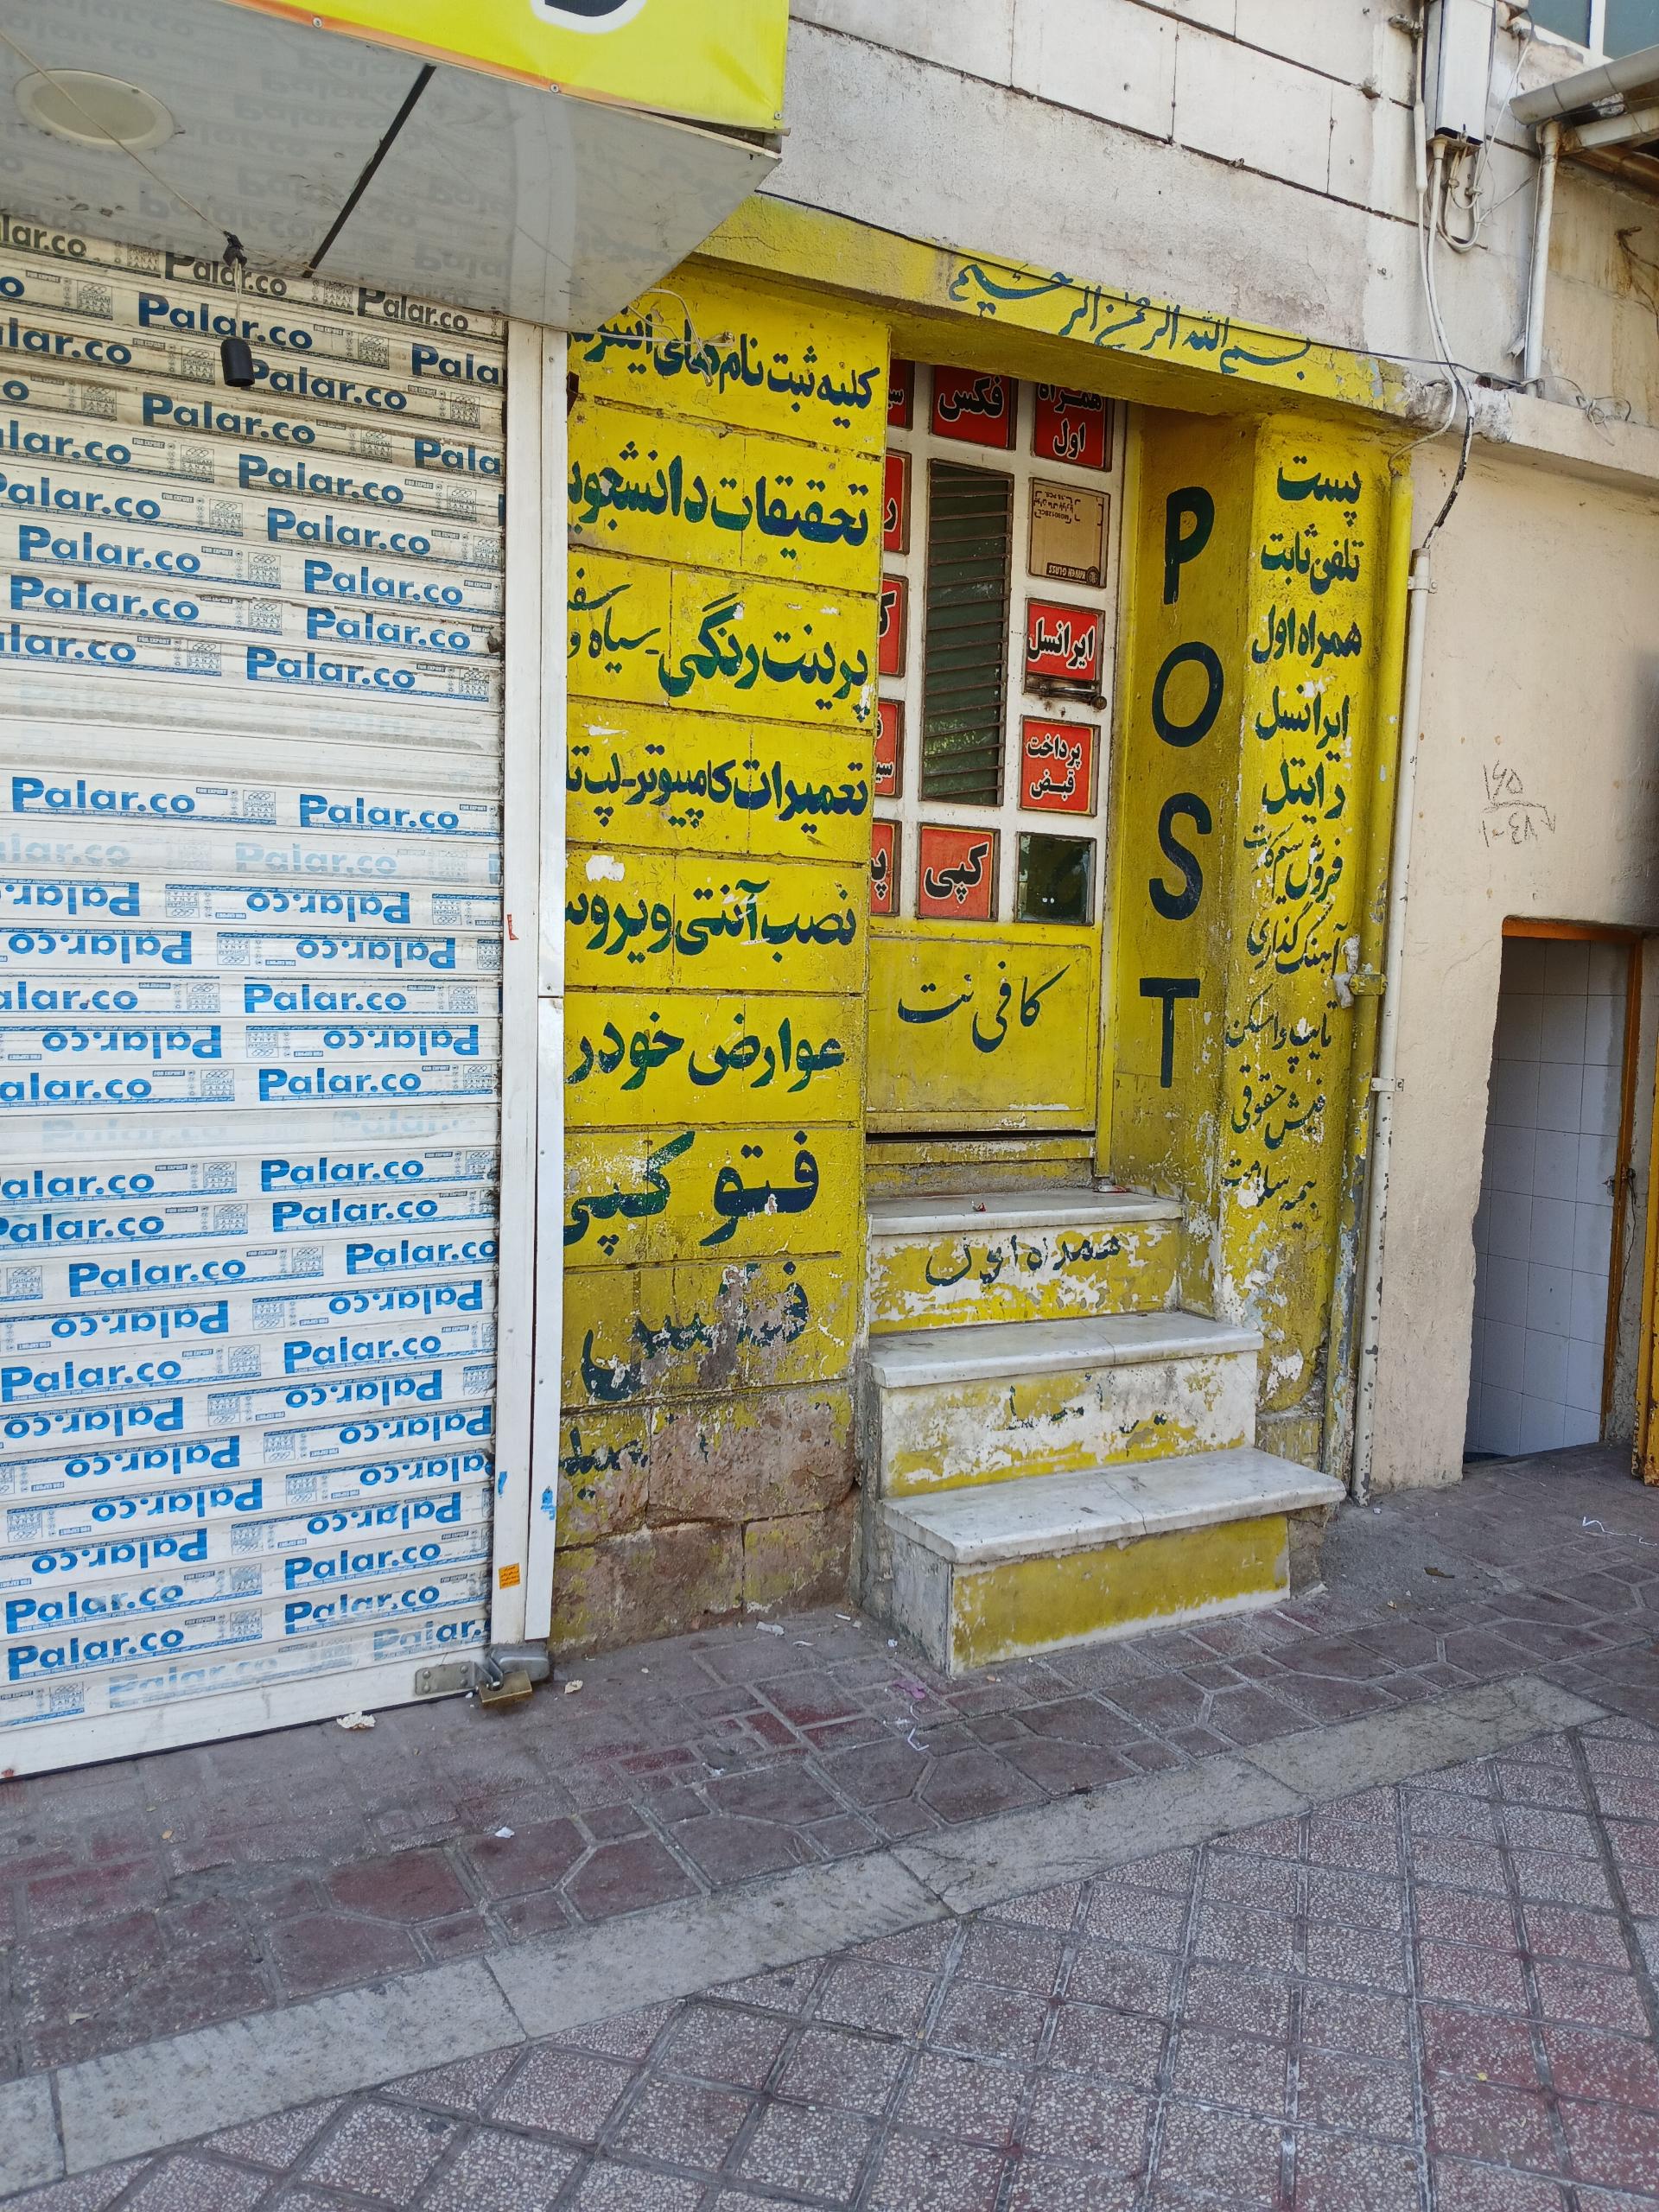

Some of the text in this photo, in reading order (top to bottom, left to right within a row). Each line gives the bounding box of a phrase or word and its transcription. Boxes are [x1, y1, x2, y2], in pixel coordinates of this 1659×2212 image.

[0, 215, 86, 257] lar.co
[165, 251, 287, 296] Palar.co
[138, 292, 312, 349] Palar.co
[358, 287, 468, 332] Palar.co
[654, 318, 720, 377] های
[719, 333, 763, 394] نام
[1220, 337, 1311, 380] بسم
[767, 346, 817, 413] ثبت
[817, 365, 880, 429] کلیه
[938, 376, 1003, 421] فکس
[143, 392, 315, 444] Palar.co
[1053, 419, 1085, 459] اول
[0, 421, 131, 466] lar.co
[0, 472, 161, 519] alar.co
[238, 453, 404, 505] Palar.co
[1277, 455, 1361, 527] پست
[267, 507, 430, 556] Palar.co
[711, 474, 868, 559] تحقیقات
[19, 524, 200, 574] Palar.co
[1261, 523, 1364, 594] تلفن ثابت
[10, 575, 199, 621] Palar.co
[304, 559, 463, 606] Palar.co
[0, 624, 136, 662] lar.co
[307, 607, 470, 651] Palar.co
[658, 591, 760, 696] رنگی
[1028, 616, 1095, 671] ایرانسل
[1251, 604, 1362, 668] همراه اول
[246, 646, 415, 690] Palar.co
[762, 623, 870, 722] پرینت
[1255, 684, 1350, 762] ایرانسل
[1026, 733, 1081, 770] پرداخت
[12, 777, 195, 813] Palar.co
[622, 743, 736, 828] کامپیوتر
[733, 759, 868, 834] تعمیرات
[1030, 769, 1076, 802] قبض
[1139, 486, 1224, 1088] POST
[1262, 757, 1345, 823] رایتل
[299, 793, 459, 830] Palar.co
[925, 842, 988, 904] کپی
[0, 882, 139, 916] Palar.
[246, 892, 410, 923] Palar.co
[676, 879, 770, 956] آنتی
[9, 931, 192, 964] Palar.co
[761, 889, 857, 963] نصب
[296, 938, 455, 969] Palar.co
[245, 983, 406, 1013] Palar.co
[897, 961, 1071, 1053] کافی نت
[42, 1026, 222, 1058] Palar.co
[323, 1025, 479, 1056] Palar.co
[689, 1012, 846, 1092] عوارض
[259, 1068, 421, 1102] Palar.co
[0, 1170, 154, 1199] alar.co
[261, 1157, 423, 1192] Palar.co
[563, 1129, 819, 1256] فتو کپی
[0, 1213, 164, 1243] alar.co
[272, 1198, 437, 1232] Palar.co
[69, 1259, 245, 1297] Palar.co
[346, 1240, 499, 1274] Palar.co
[52, 1300, 228, 1338] Palar.co
[328, 1280, 483, 1314] Palar.co
[284, 1336, 441, 1374] Palar.co
[1, 1361, 181, 1402] Palar.co
[285, 1370, 442, 1408] Palar.co
[4, 1396, 183, 1438] Palar.co
[340, 1405, 493, 1445] Palar.co
[65, 1435, 240, 1478] Palar.co
[92, 1478, 263, 1522] Palar.co
[307, 1491, 461, 1535] Palar.co
[32, 1528, 207, 1573] Palar.co
[284, 1543, 441, 1590] Palar.co
[6, 1585, 183, 1635] Palar.co
[284, 1586, 440, 1635] Palar.co
[8, 1630, 184, 1681] Palar.co
